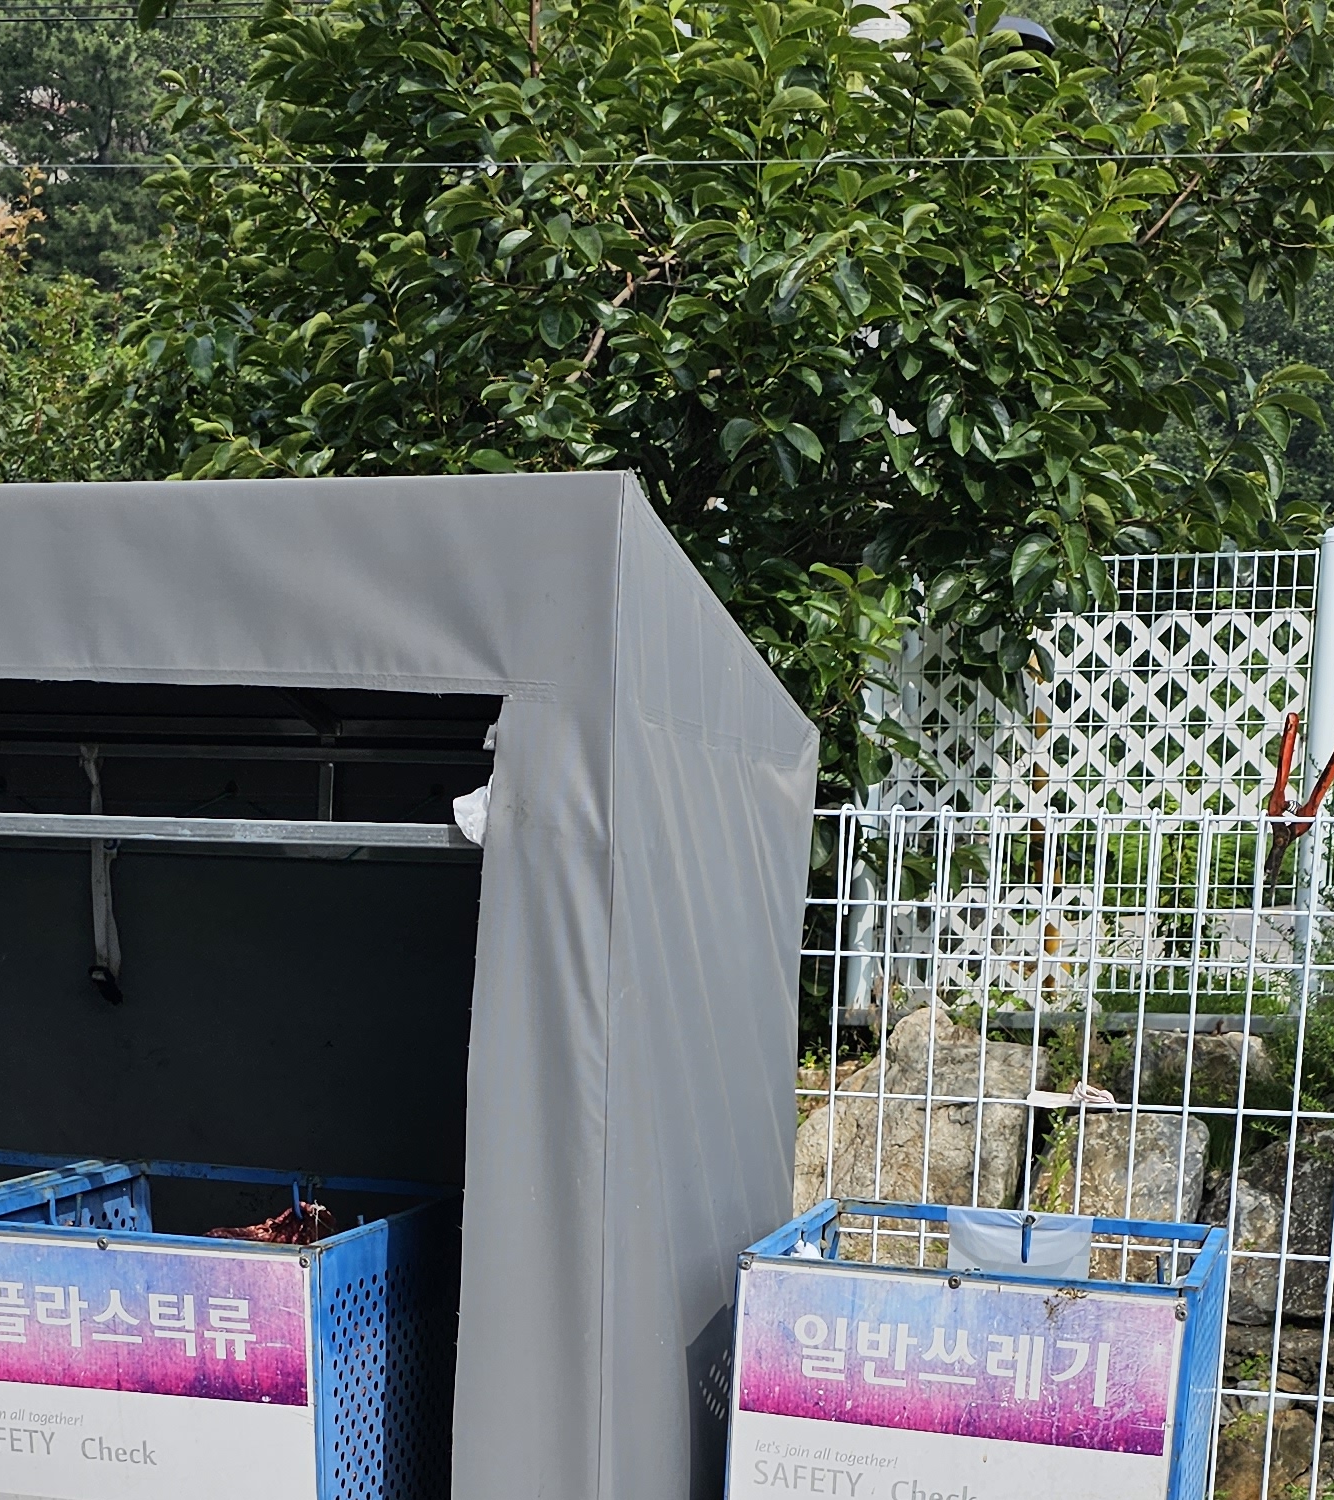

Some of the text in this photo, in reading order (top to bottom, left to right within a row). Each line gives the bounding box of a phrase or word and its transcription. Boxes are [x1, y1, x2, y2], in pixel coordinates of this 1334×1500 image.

[792, 1314, 1111, 1408] 일반쓰레기
[10, 1409, 25, 1421] all
[29, 1412, 84, 1426] together!
[80, 1436, 157, 1466] Check
[755, 1440, 898, 1469] let's join all together!
[753, 1460, 864, 1497] SAFETY
